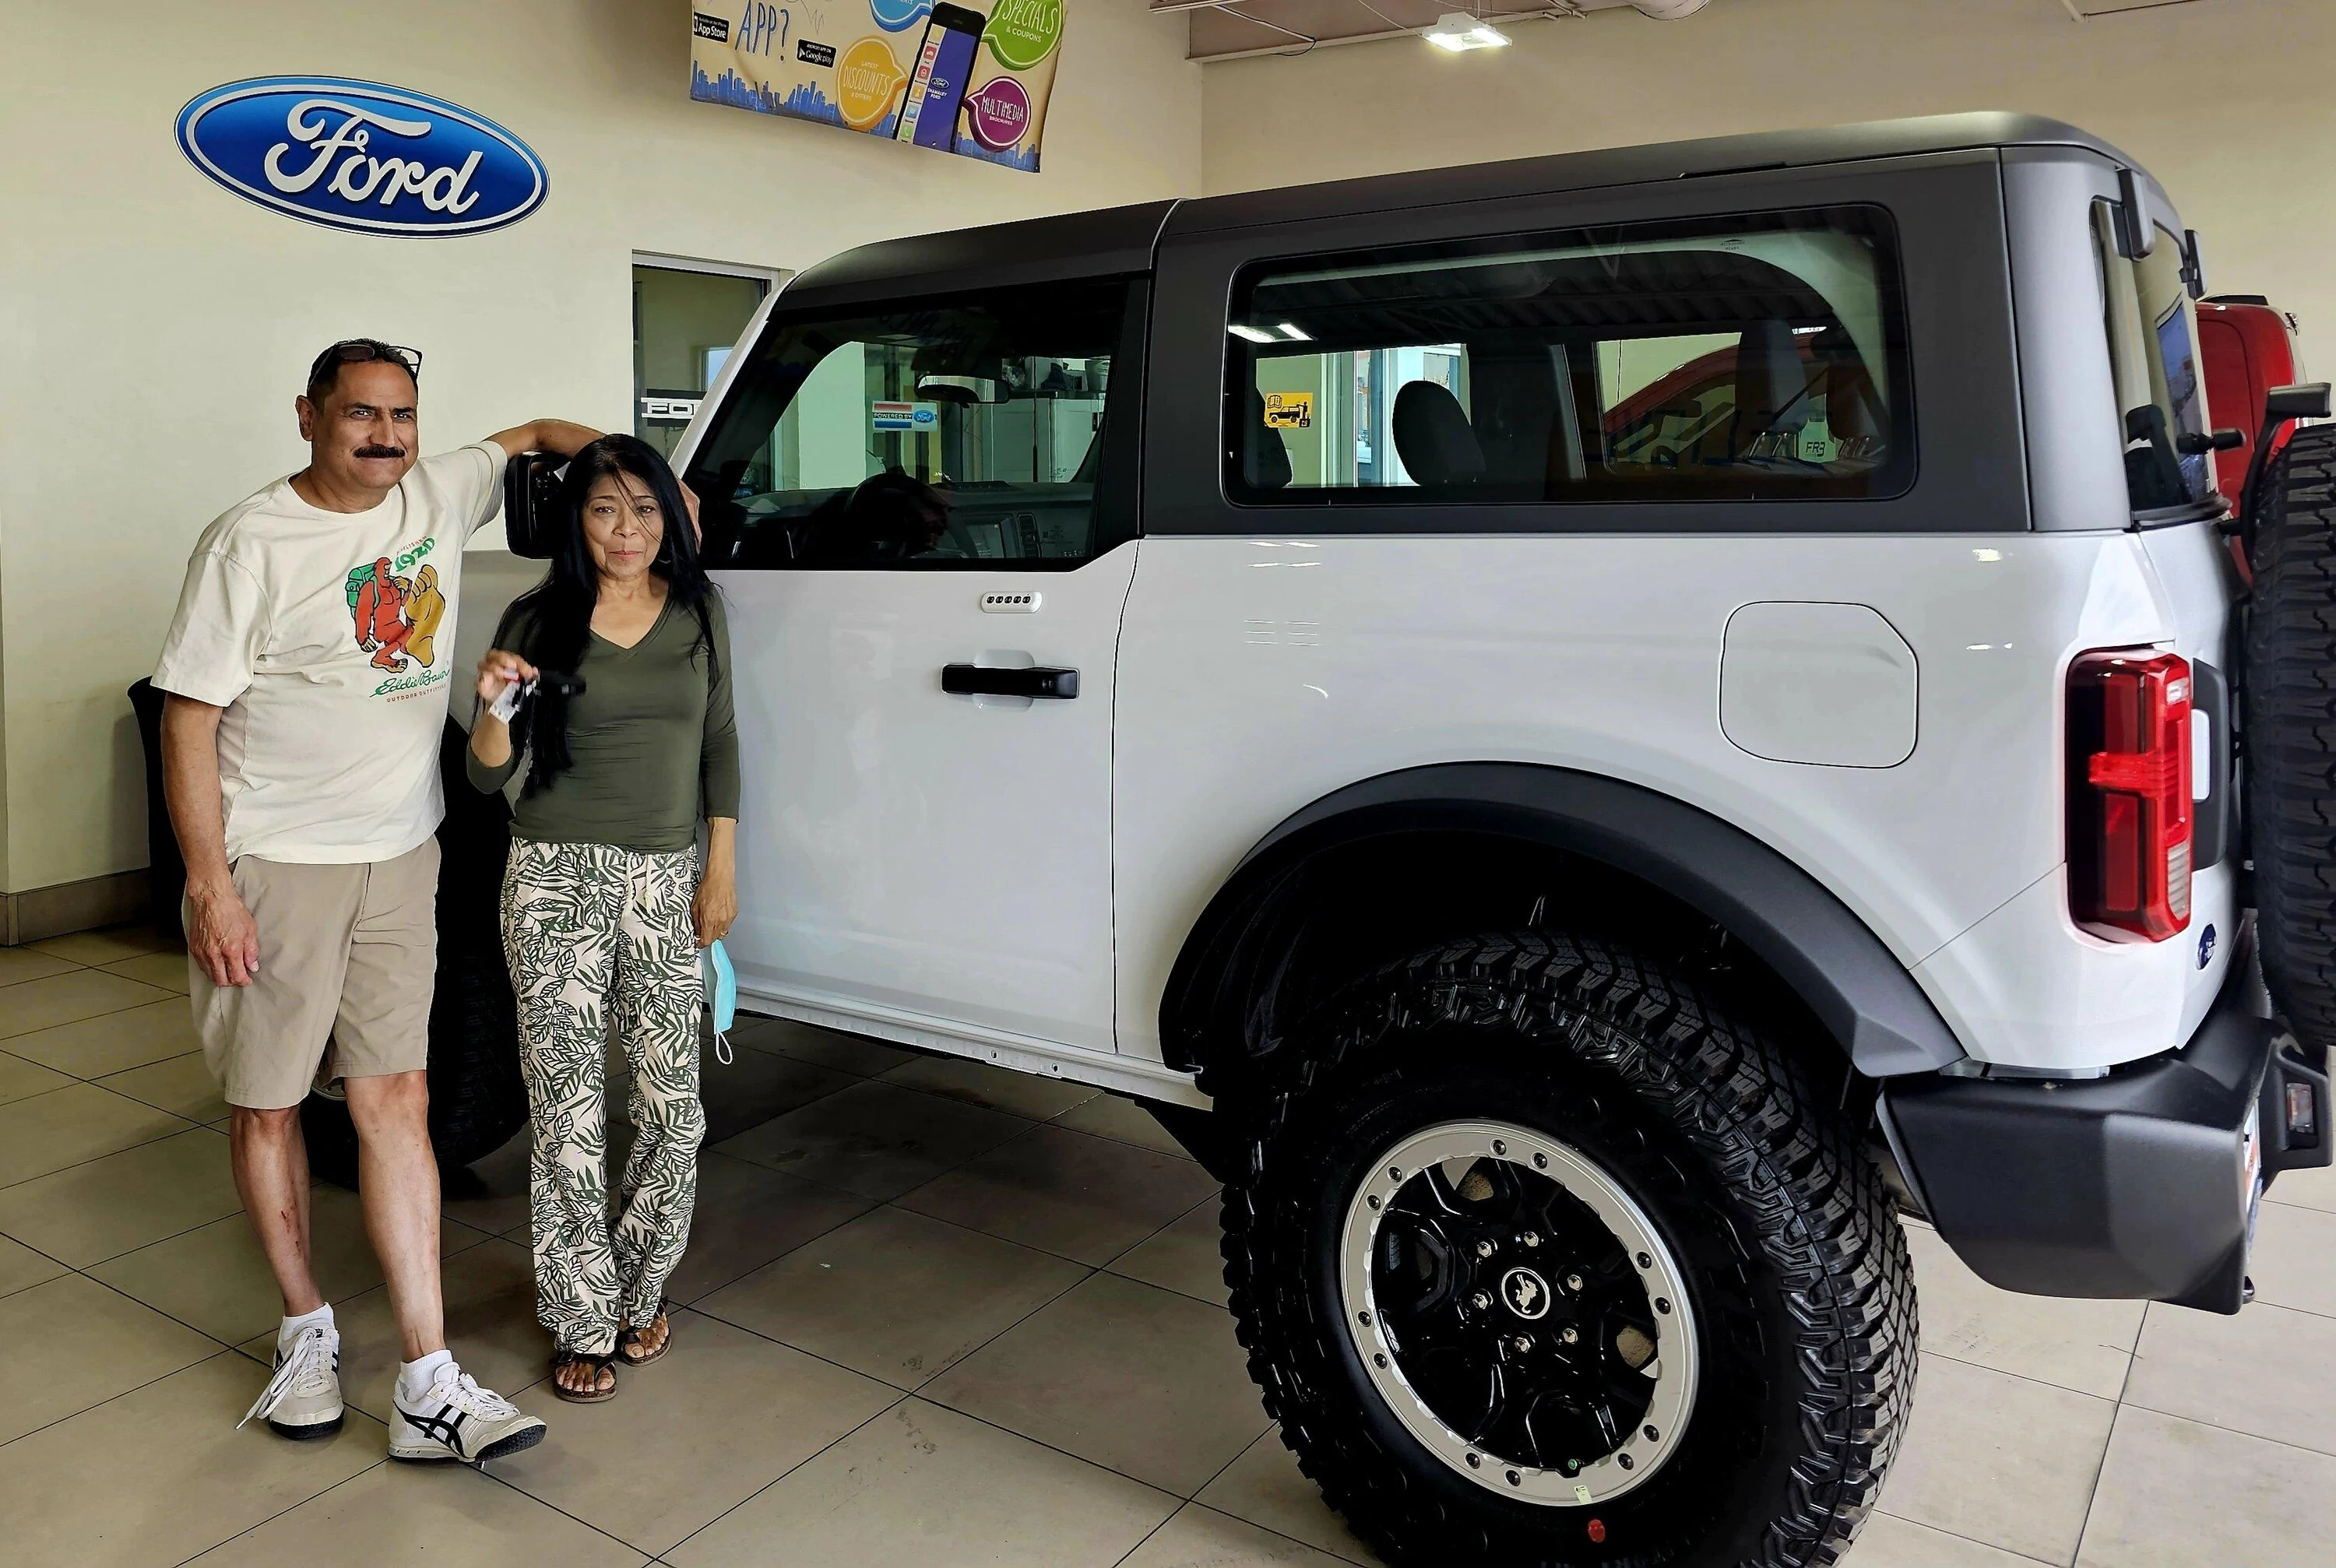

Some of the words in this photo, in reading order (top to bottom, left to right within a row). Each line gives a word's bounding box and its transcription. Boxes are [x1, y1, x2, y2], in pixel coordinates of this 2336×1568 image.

[698, 23, 710, 37] App
[710, 26, 726, 39] Store
[734, 0, 790, 62] APP?
[1002, 0, 1058, 34] SPECIALS
[1012, 28, 1042, 43] COUPONS
[805, 50, 822, 62] Google
[843, 65, 891, 96] DISCOUNTS
[981, 96, 1024, 122] MULTIMEDIA
[264, 99, 484, 214] Ford
